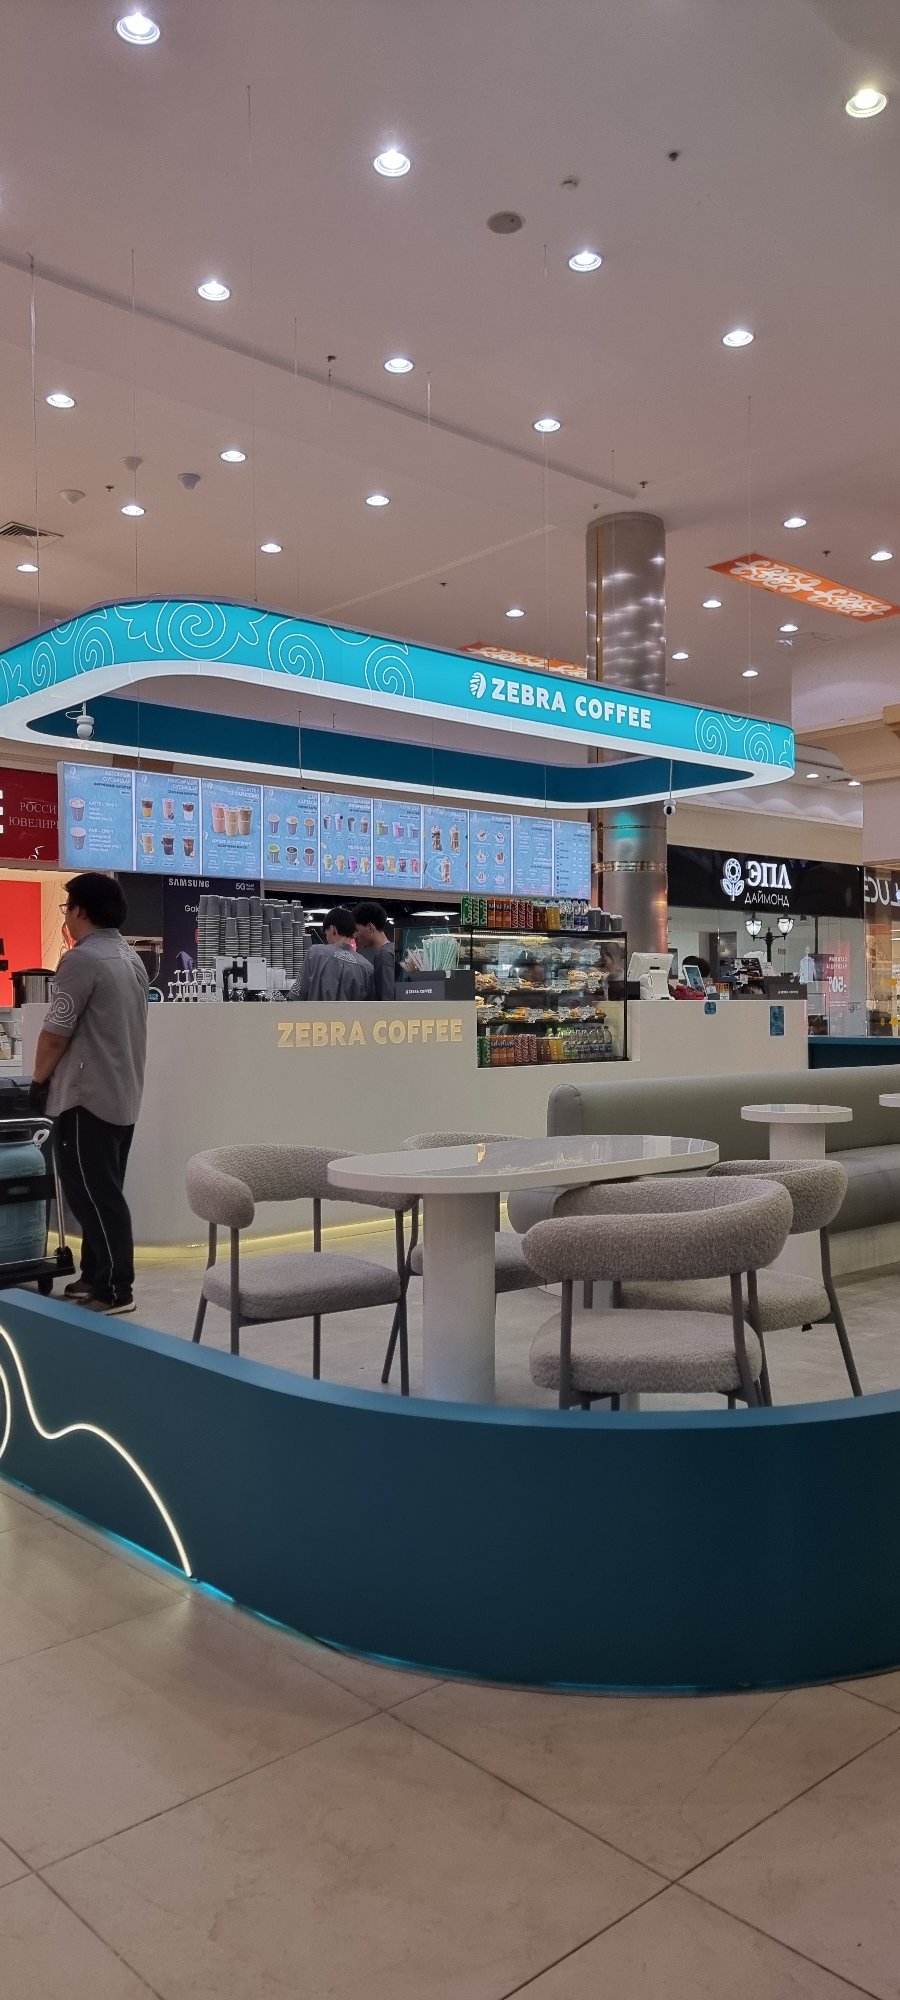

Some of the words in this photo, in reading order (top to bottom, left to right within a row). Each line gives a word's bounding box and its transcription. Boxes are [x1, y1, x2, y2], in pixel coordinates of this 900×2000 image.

[491, 677, 567, 713] ZEBRA
[575, 695, 652, 730] COFFEE
[168, 877, 210, 888] SAMSUNG
[746, 860, 792, 890] ЭПЛ
[184, 904, 200, 913] Gal
[744, 890, 790, 908] ДАЙМОНД
[277, 1020, 366, 1048] ZEBRA
[372, 1018, 463, 1045] COFFEE
